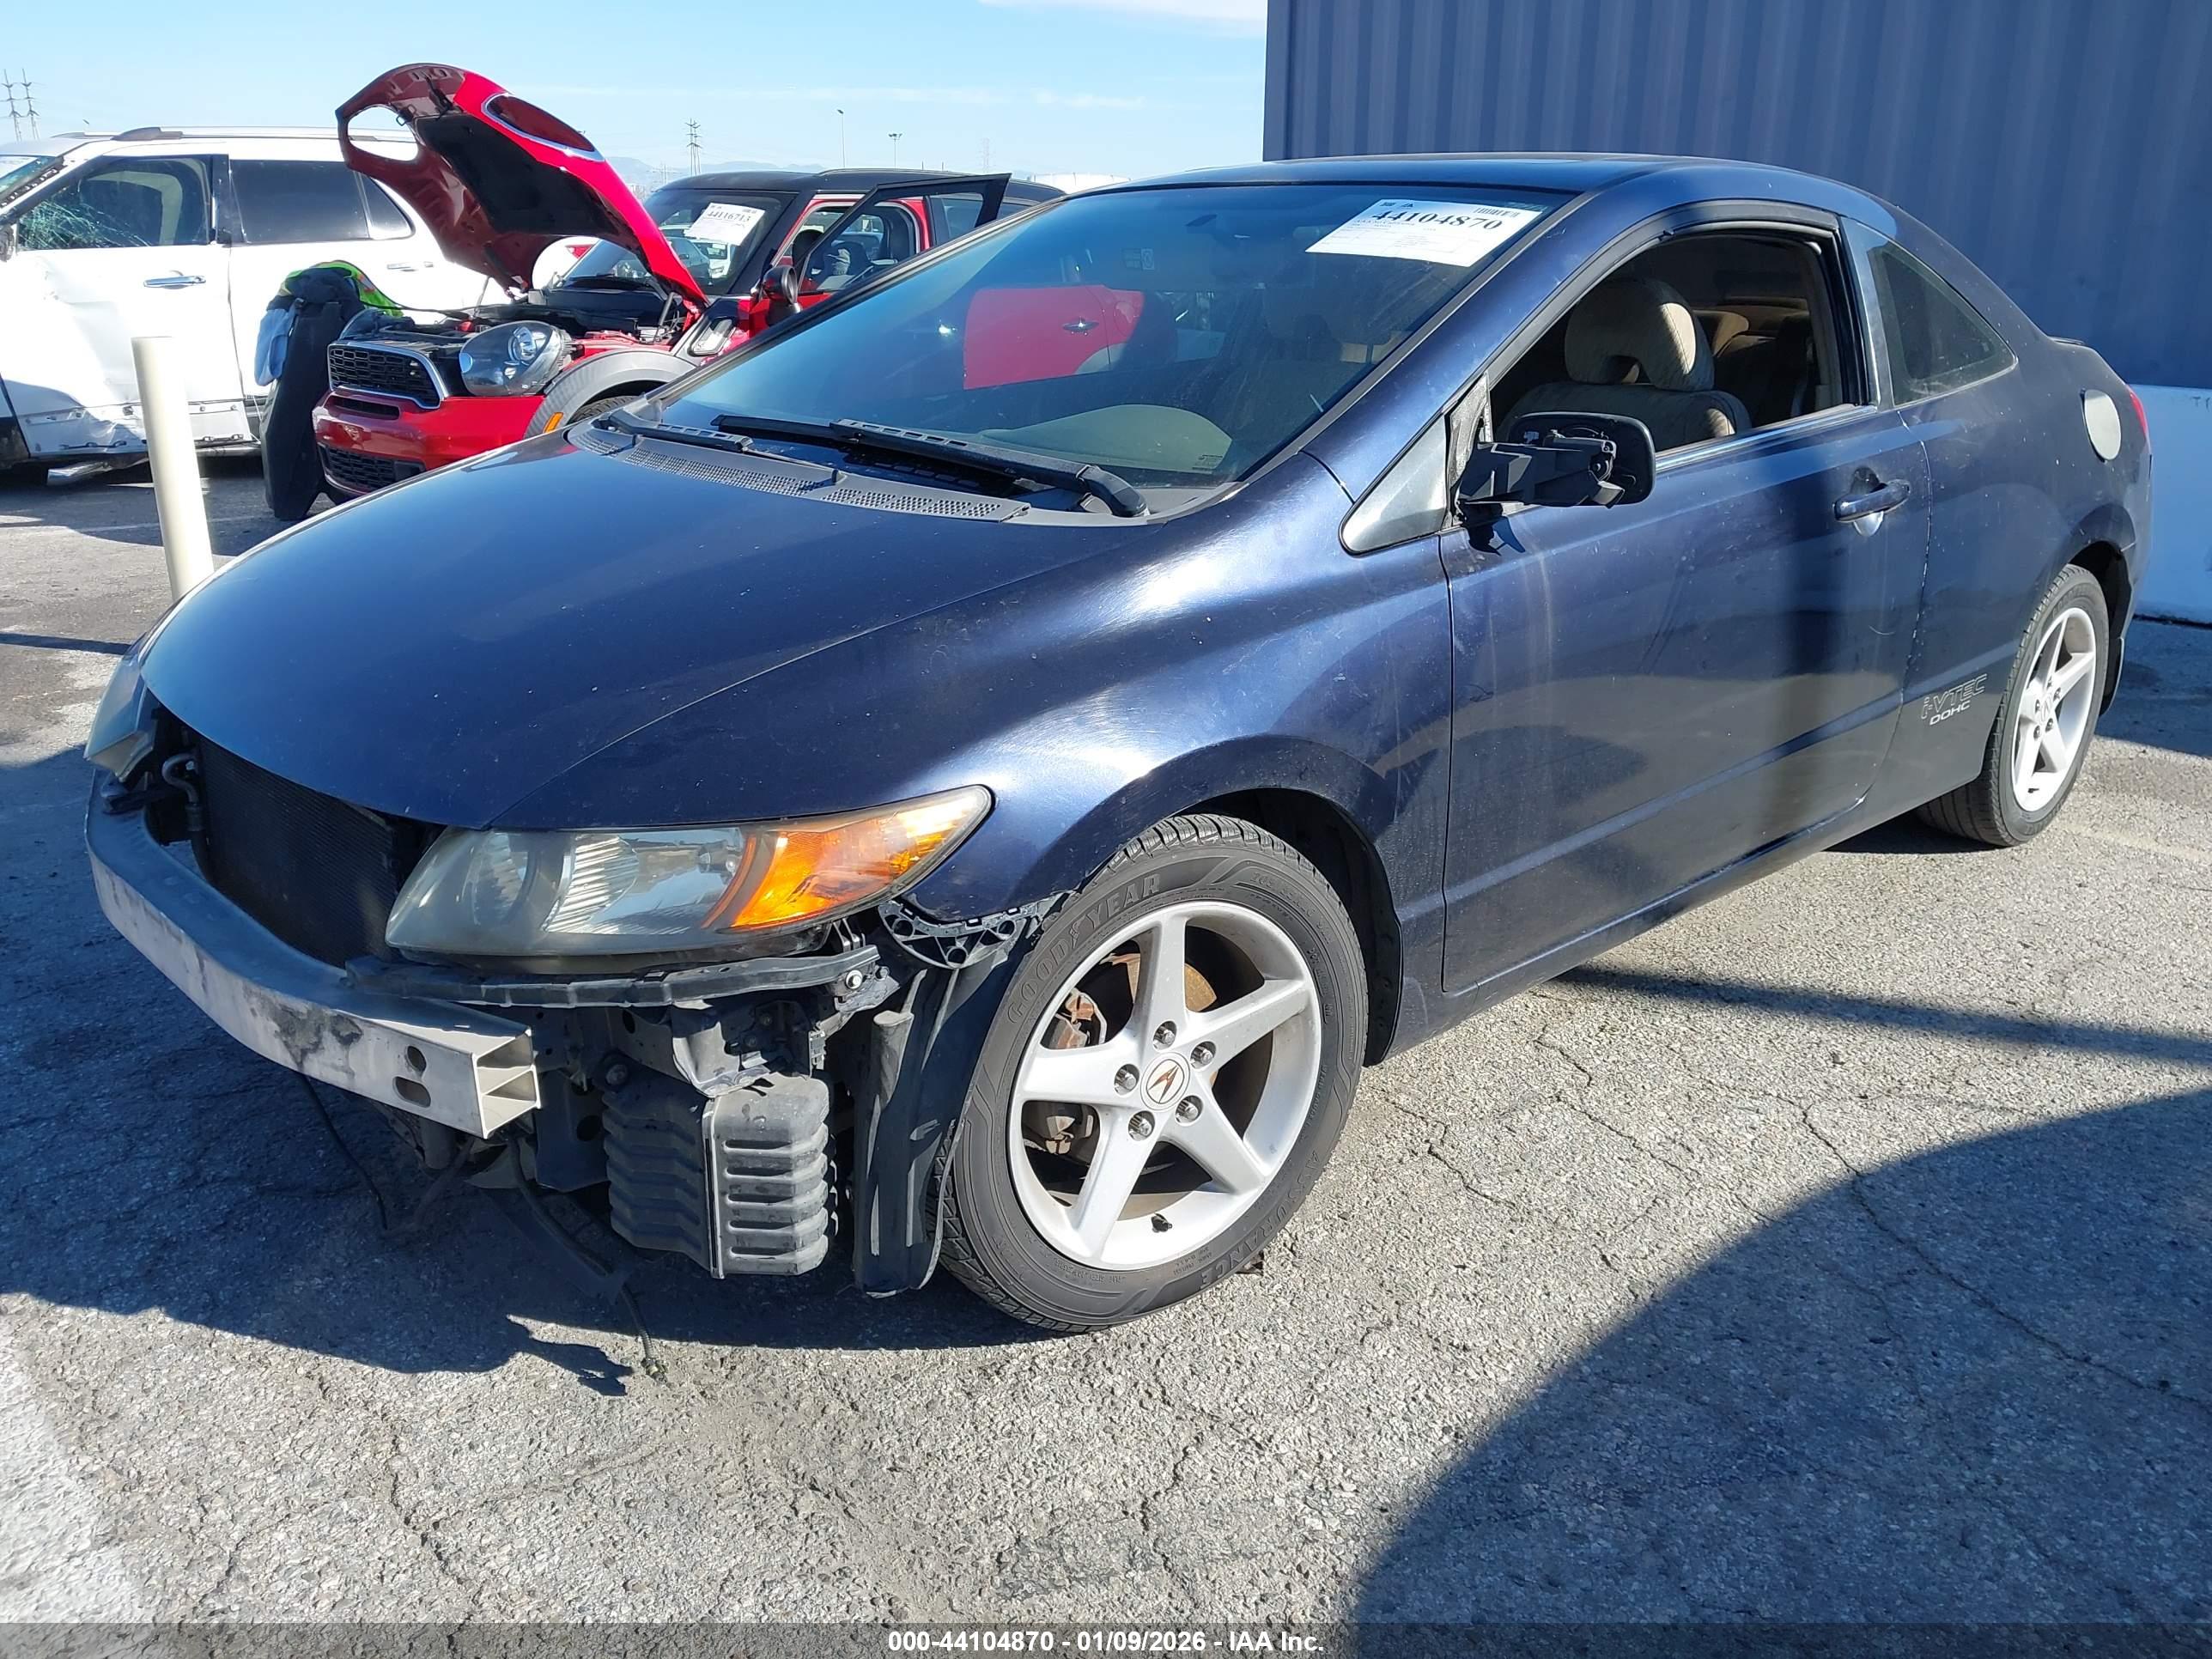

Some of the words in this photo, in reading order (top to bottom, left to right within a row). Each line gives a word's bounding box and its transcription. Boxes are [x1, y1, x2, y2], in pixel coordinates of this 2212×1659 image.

[1371, 210, 1503, 230] 44104870
[1929, 700, 1971, 726] DOHC
[1007, 873, 1160, 1024] GOODYEAR
